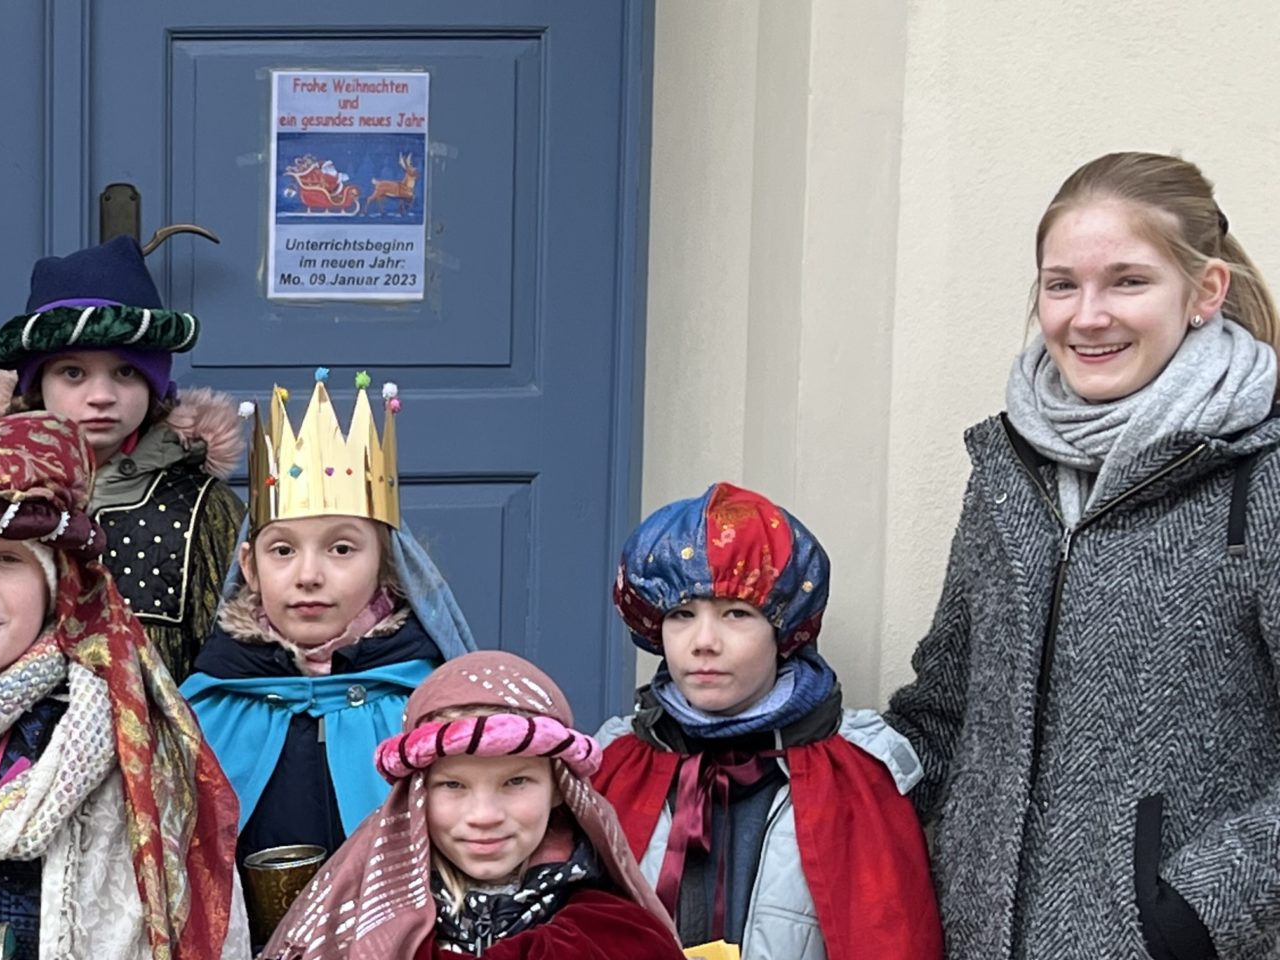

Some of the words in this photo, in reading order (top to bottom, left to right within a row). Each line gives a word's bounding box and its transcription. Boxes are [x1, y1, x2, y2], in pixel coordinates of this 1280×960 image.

[293, 78, 327, 93] Frohe
[333, 78, 409, 94] Weihnachten
[338, 96, 360, 110] und
[279, 113, 297, 126] ein
[301, 113, 354, 131] gesundes
[359, 115, 391, 127] neues
[397, 113, 425, 127] Jahr
[285, 238, 414, 254] Unterrichtsbeginn
[299, 256, 316, 269] im
[320, 258, 364, 269] neuen
[279, 273, 304, 286] Mo.
[383, 273, 417, 286] 2023
